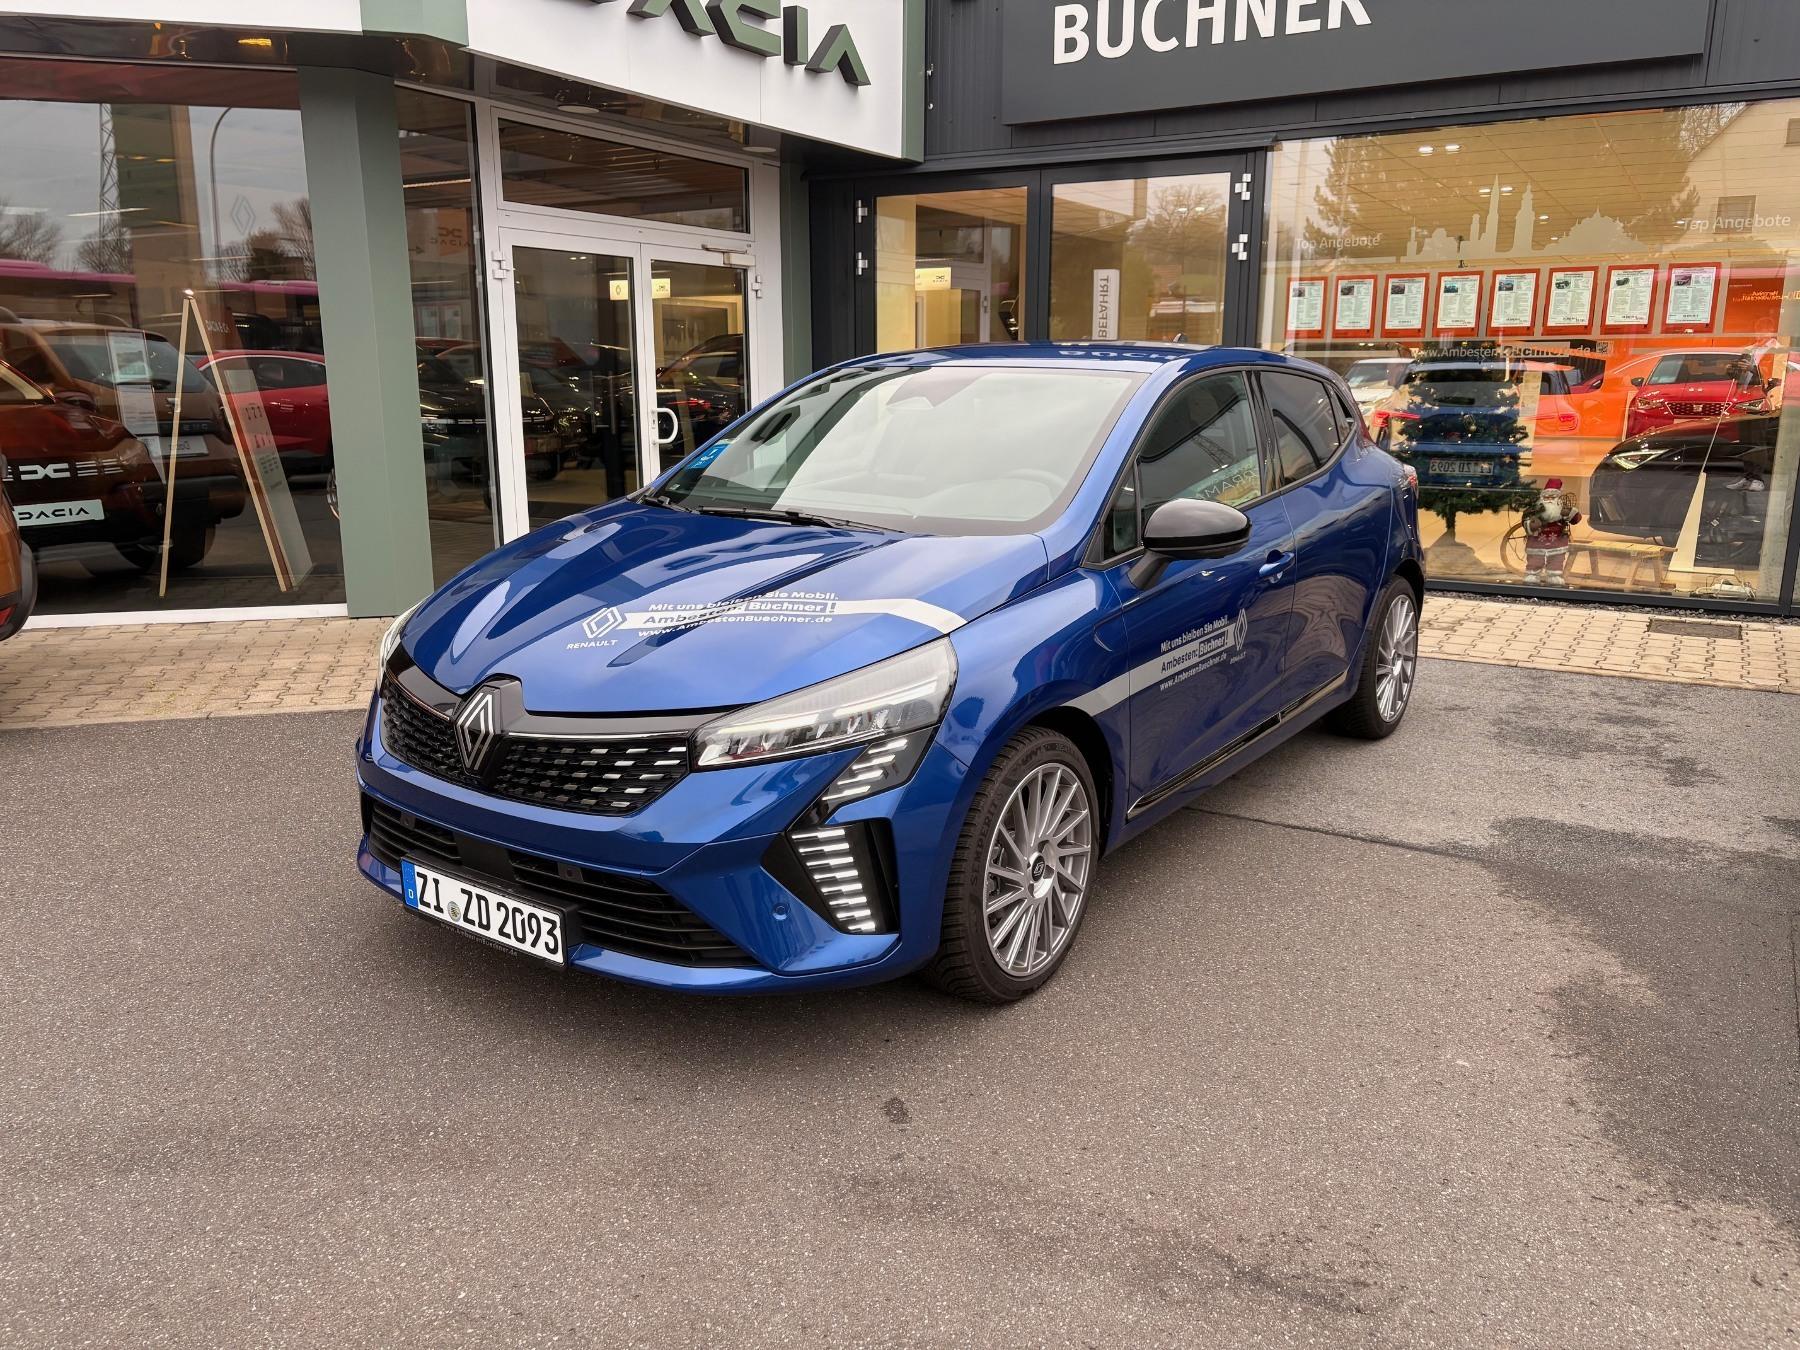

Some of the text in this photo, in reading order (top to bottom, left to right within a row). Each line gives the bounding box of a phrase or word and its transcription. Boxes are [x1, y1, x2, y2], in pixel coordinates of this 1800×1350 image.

[577, 0, 871, 87] CIA
[1713, 213, 1791, 232] Angebote
[1319, 234, 1380, 251] Angebote
[18, 506, 90, 520] DACIA
[648, 603, 674, 611] Mit
[706, 594, 762, 609] bleiben
[791, 592, 839, 600] Mobil.
[748, 601, 824, 612] Büchner
[1182, 626, 1204, 642] bleiben
[1204, 622, 1213, 633] Sie
[566, 639, 618, 650] RENAULT
[1199, 635, 1224, 656] Büchner
[416, 871, 444, 914] ZI
[460, 887, 491, 931] ZD
[496, 901, 559, 955] 2093
